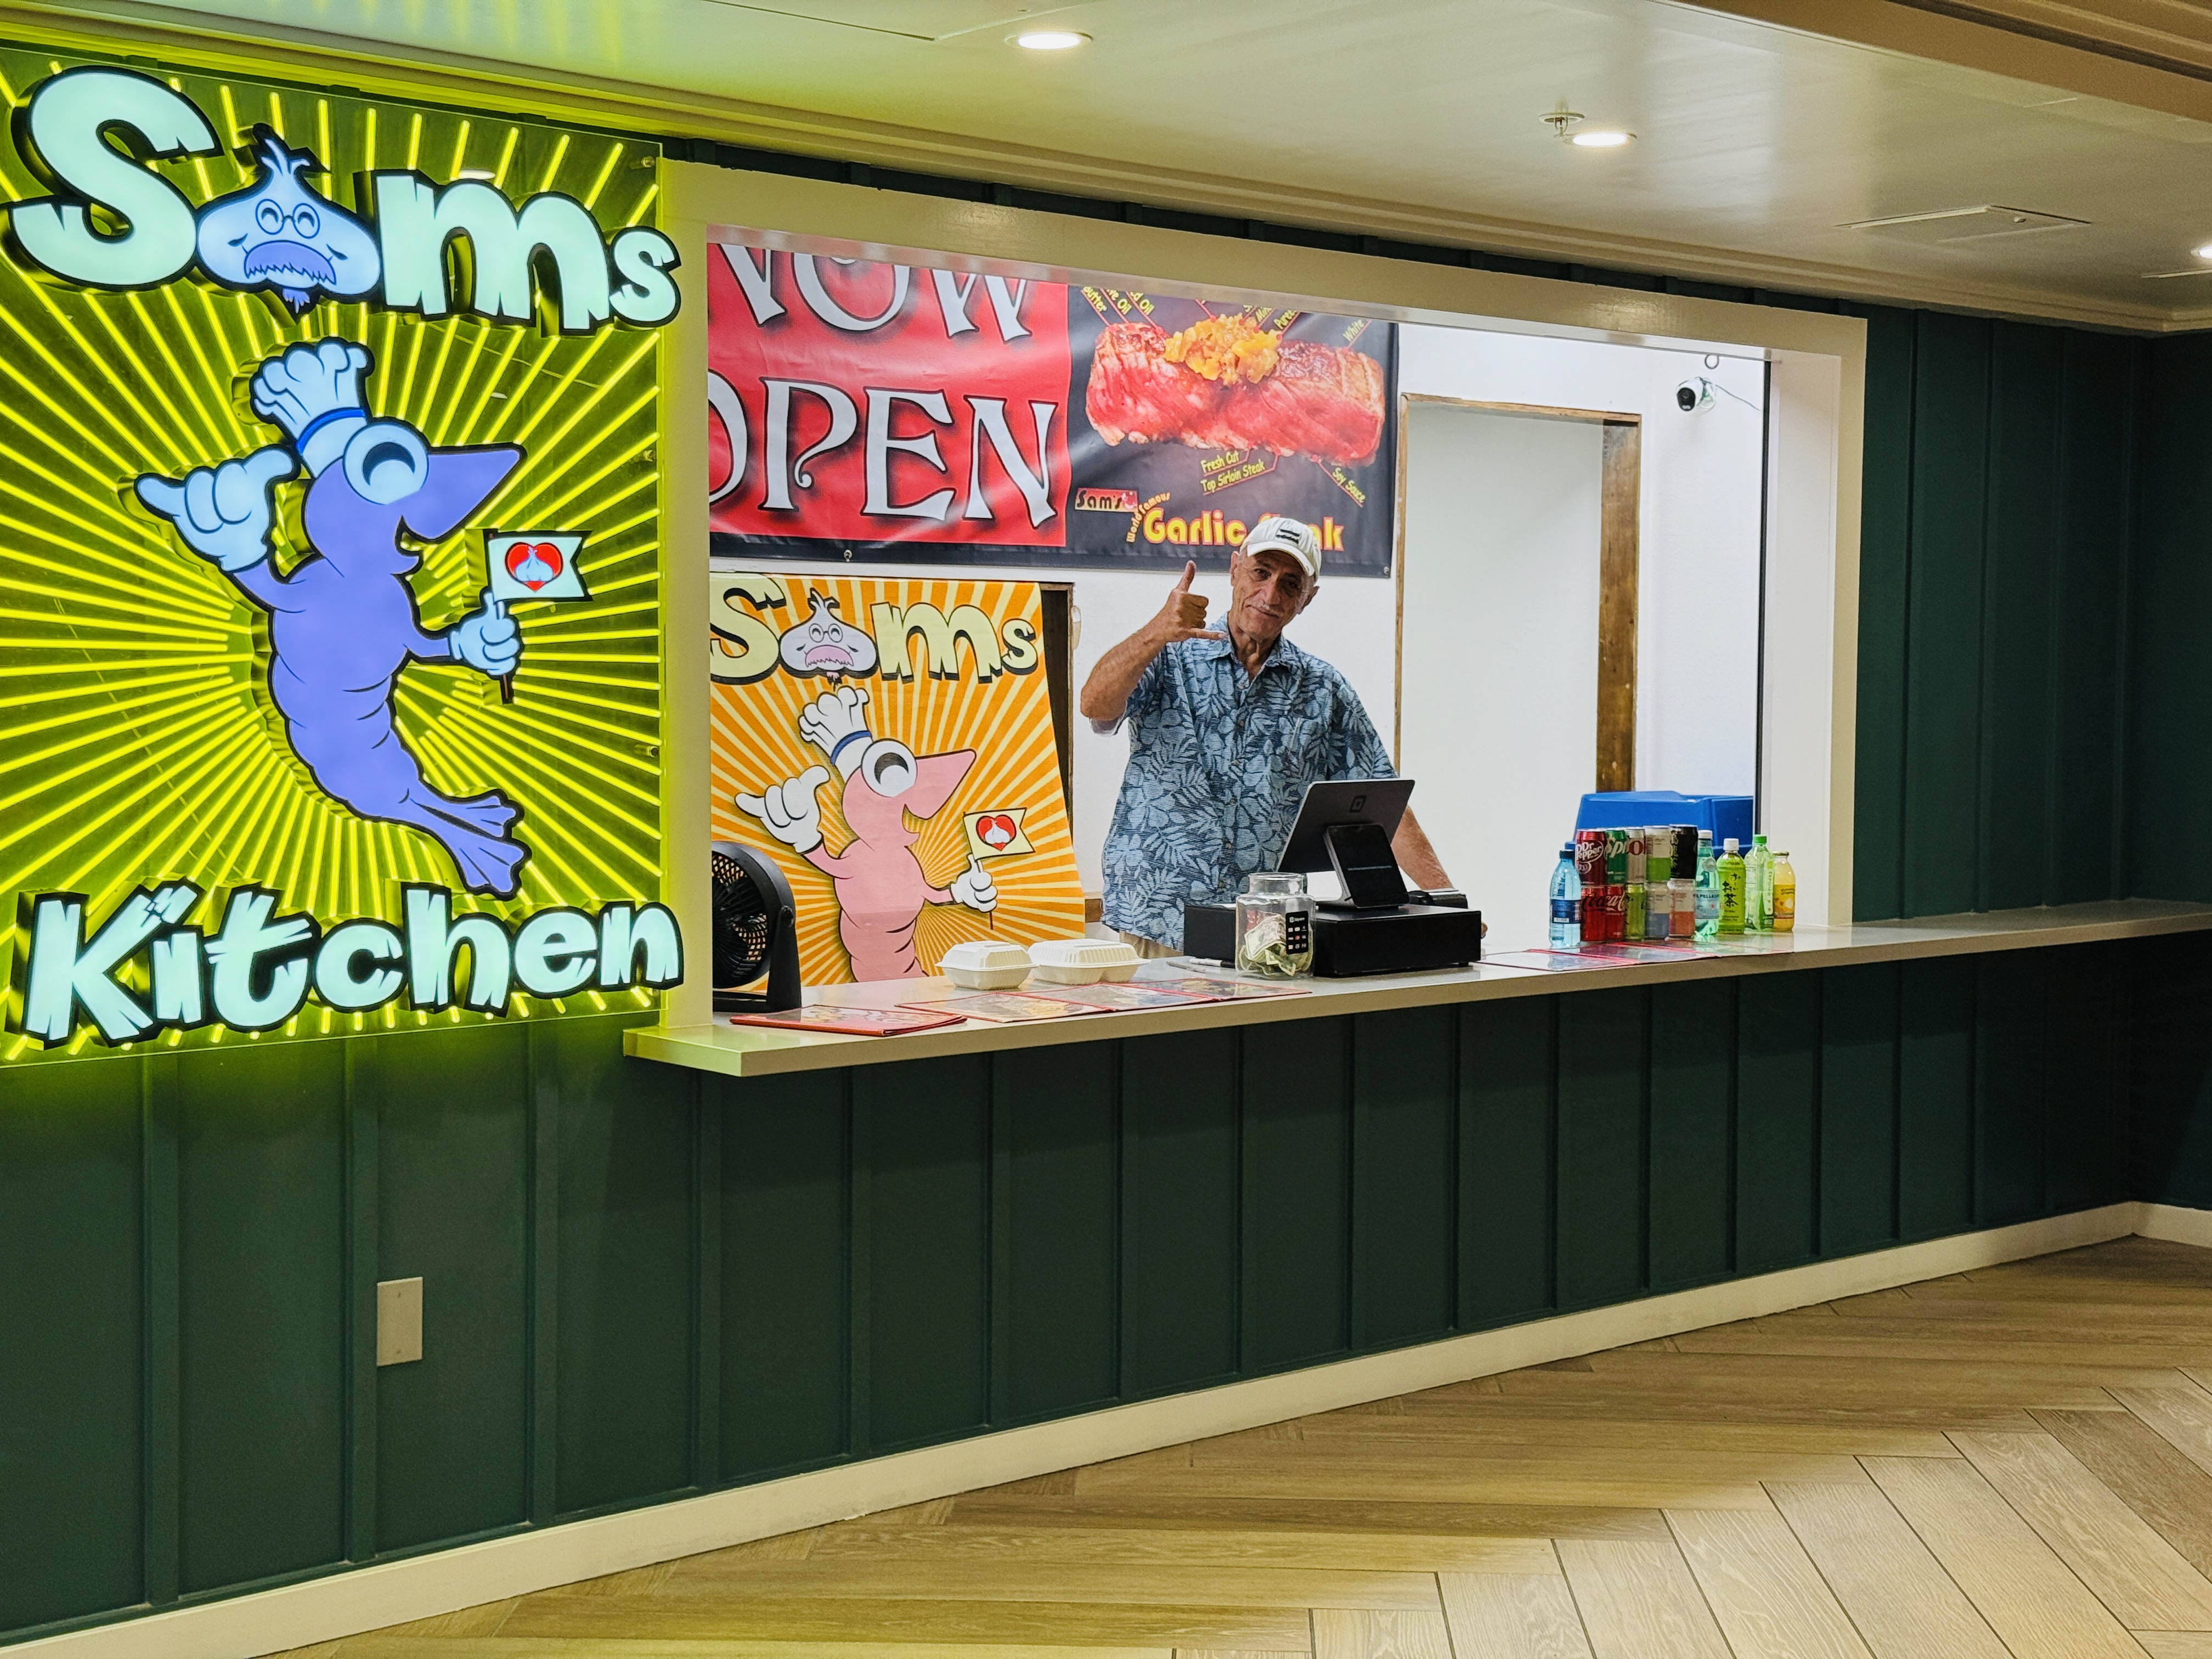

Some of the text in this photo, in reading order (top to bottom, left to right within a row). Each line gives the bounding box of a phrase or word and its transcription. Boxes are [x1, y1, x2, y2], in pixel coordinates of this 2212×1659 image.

[1200, 450, 1240, 473] Fresh Cut
[1200, 459, 1266, 493] Top Sirloin Steak
[1333, 467, 1365, 503] Soy Sauce
[1076, 490, 1122, 510] Sam's
[1143, 507, 1248, 546] Garlic
[1575, 844, 1602, 861] Pepper
[1582, 842, 1594, 851] Dr
[22, 878, 684, 1047] Kitchen
